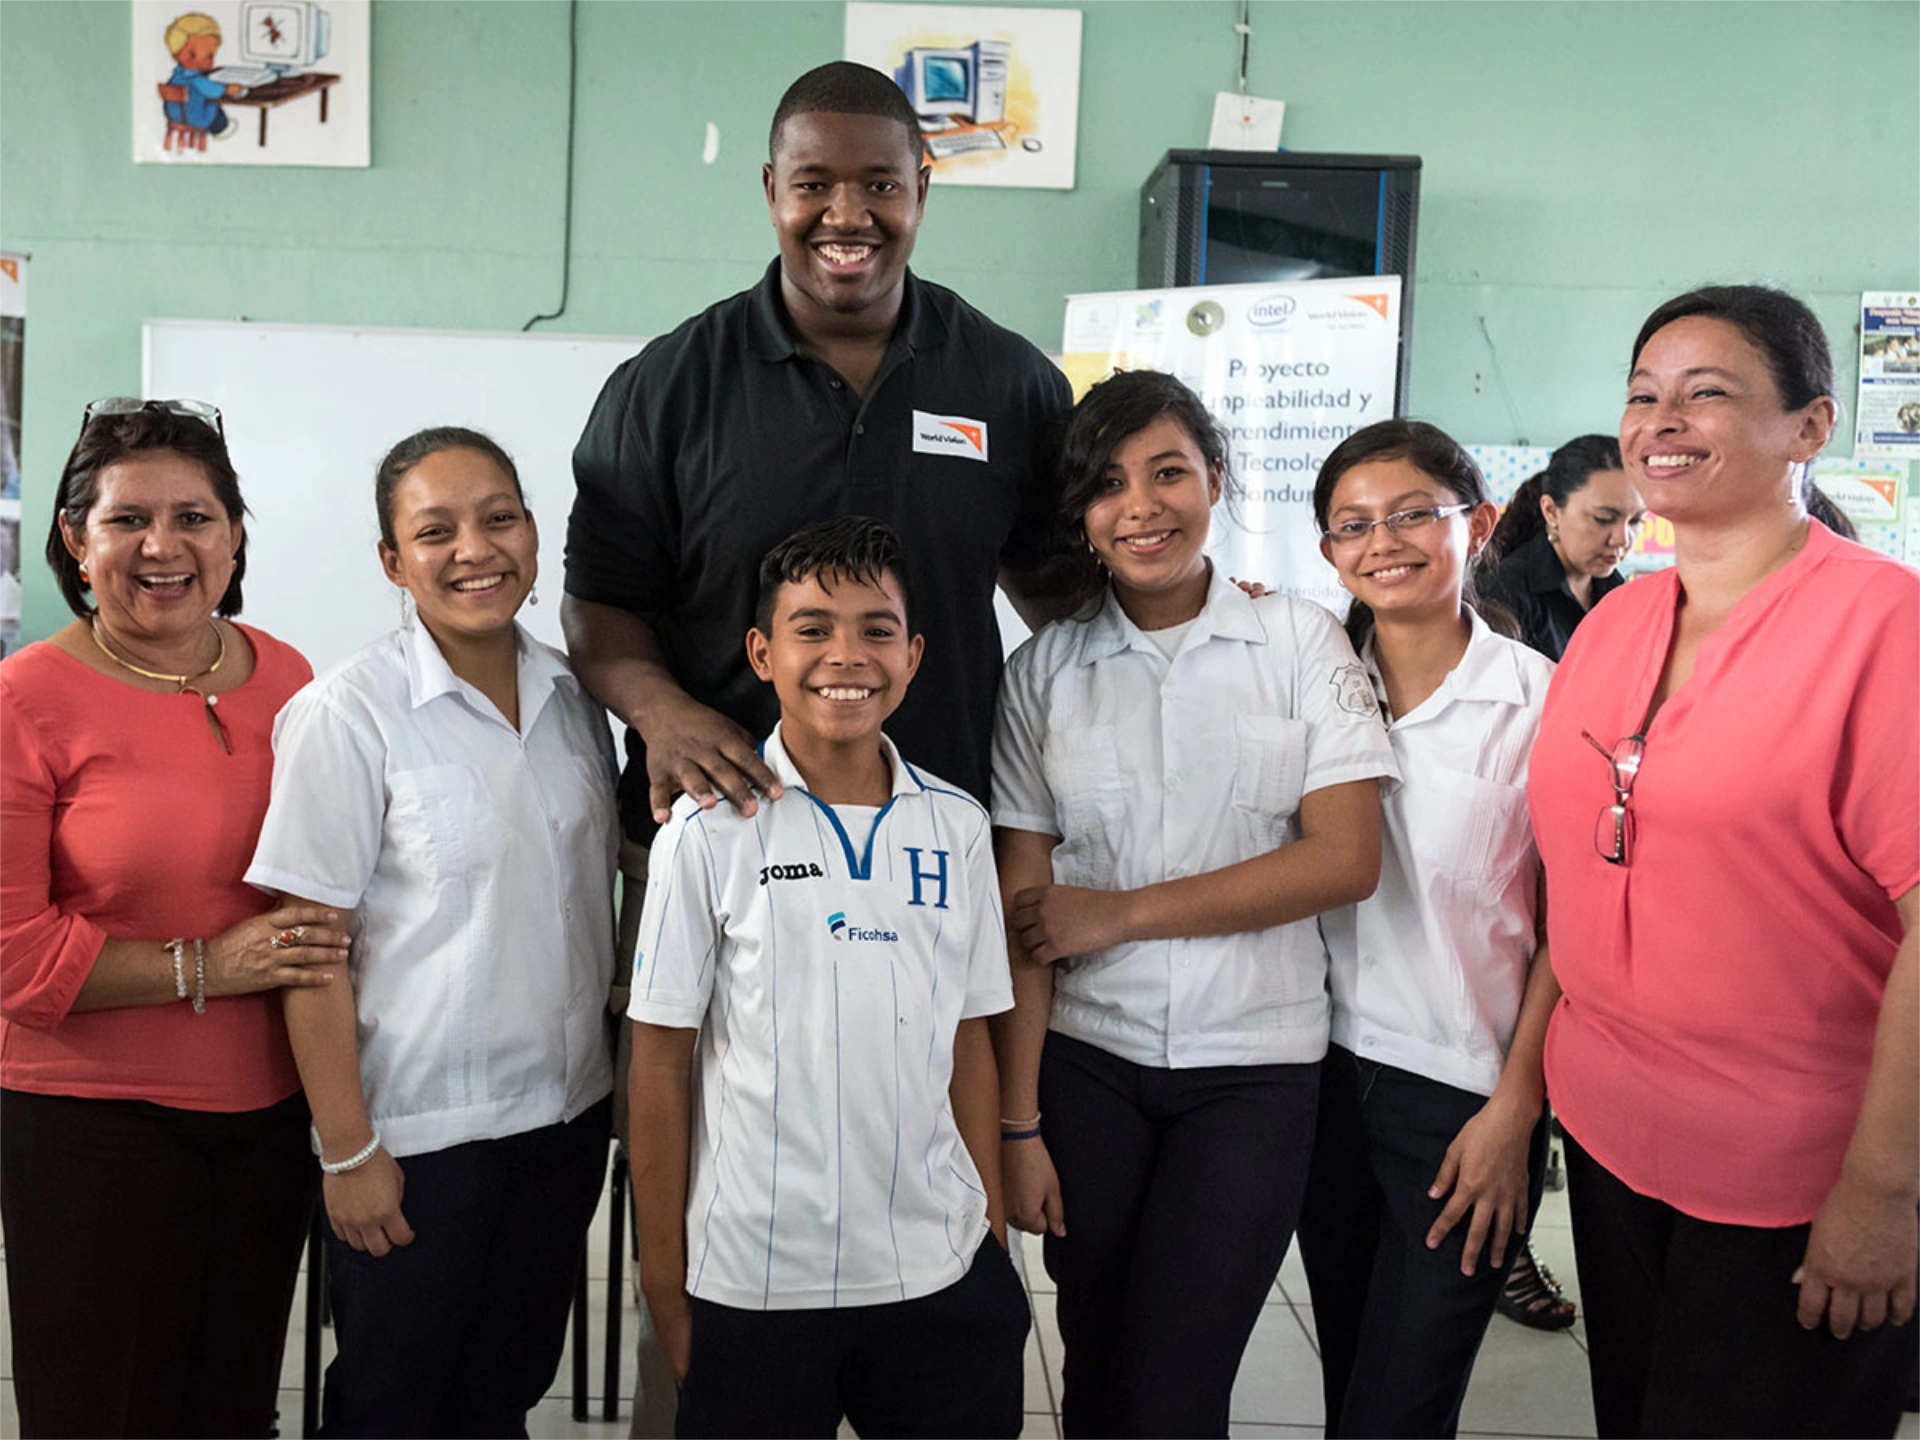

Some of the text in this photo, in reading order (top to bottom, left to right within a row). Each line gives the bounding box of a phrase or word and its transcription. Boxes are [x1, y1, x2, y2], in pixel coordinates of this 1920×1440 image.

[1253, 302, 1289, 317] intel
[1228, 359, 1330, 383] Proyecto
[1359, 393, 1373, 413] y
[903, 847, 949, 909] H
[849, 927, 899, 942] Ficohsa
